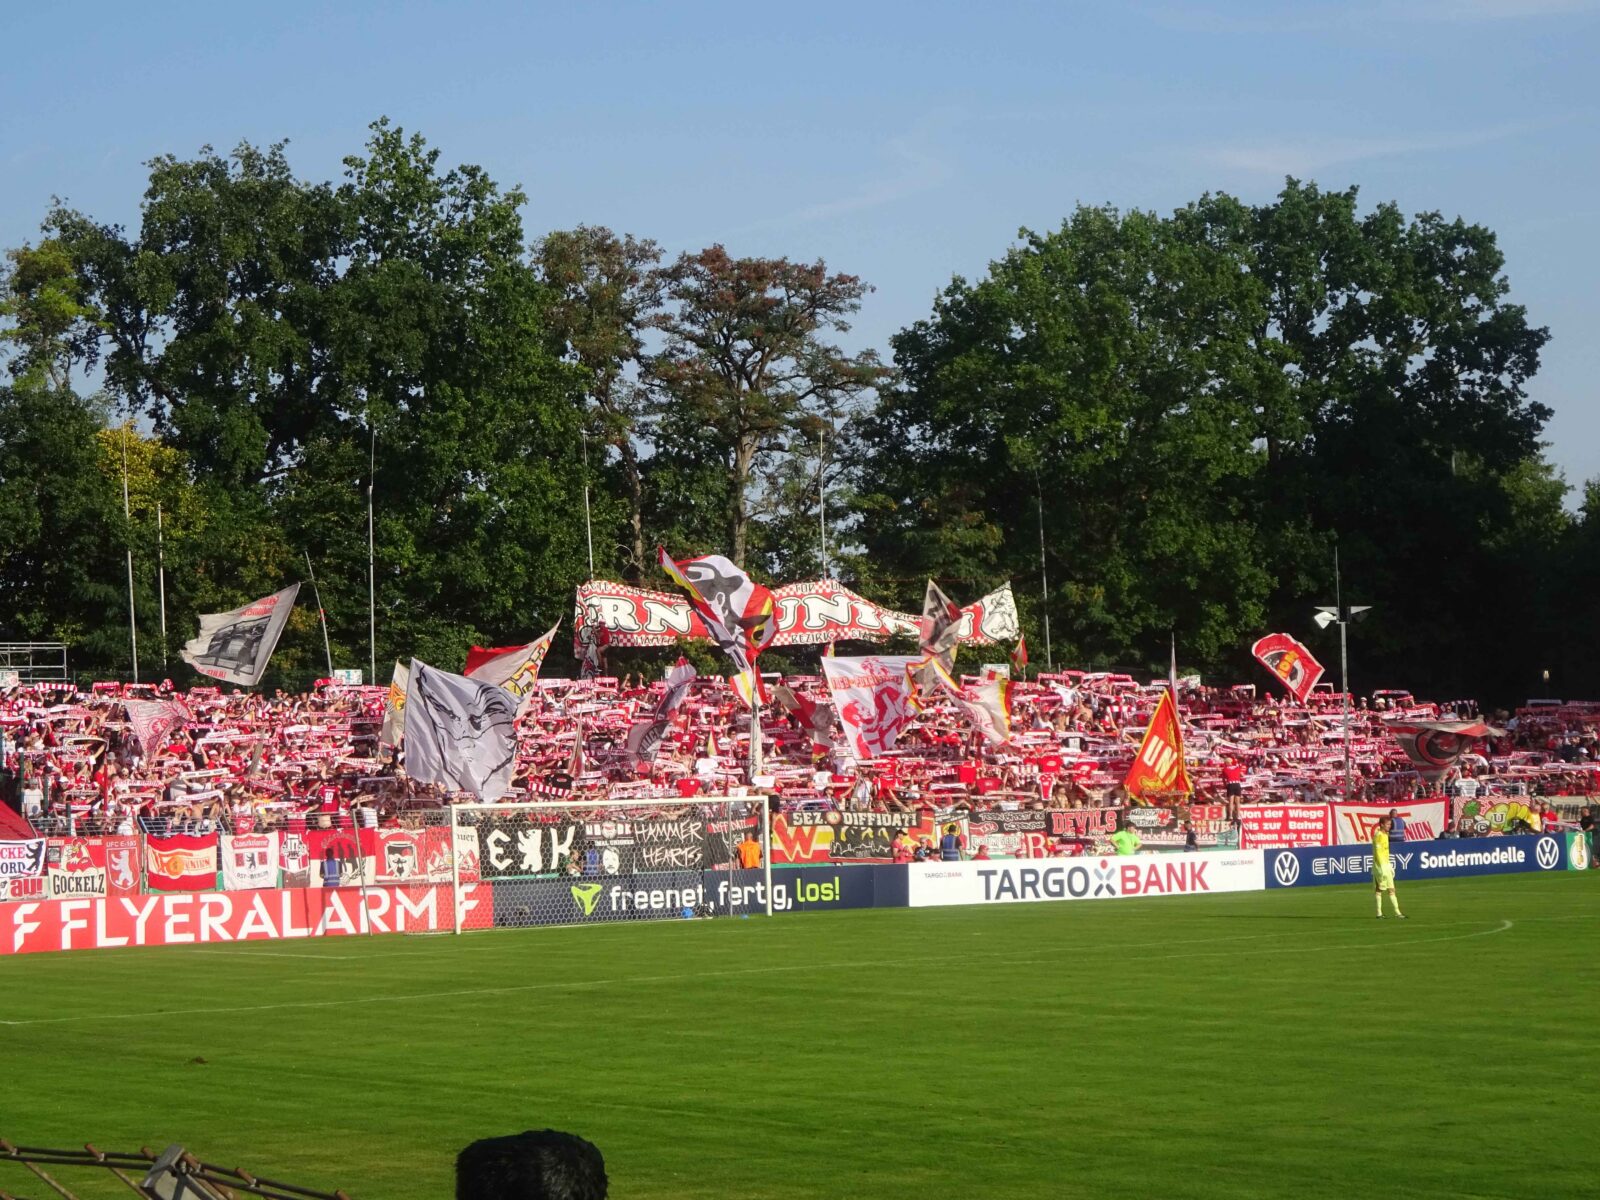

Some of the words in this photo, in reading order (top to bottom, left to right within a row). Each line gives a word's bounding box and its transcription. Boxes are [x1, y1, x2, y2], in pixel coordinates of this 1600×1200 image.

[1051, 809, 1118, 835] DEVILS
[1263, 821, 1281, 830] zur
[1288, 820, 1324, 830] Bahre
[1264, 809, 1284, 819] der
[1288, 808, 1325, 819] Wiege
[634, 819, 704, 844] HAMMER
[1281, 832, 1297, 840] wir
[1301, 832, 1324, 840] treu
[1403, 821, 1435, 842] NION
[643, 845, 703, 868] HEARTS
[1420, 847, 1526, 870] Sondermodelle
[52, 873, 105, 896] GOCKELZ
[609, 884, 714, 911] freenet,
[717, 881, 793, 910] fertg,
[796, 876, 841, 902] los!
[60, 887, 438, 951] FLYERALARM
